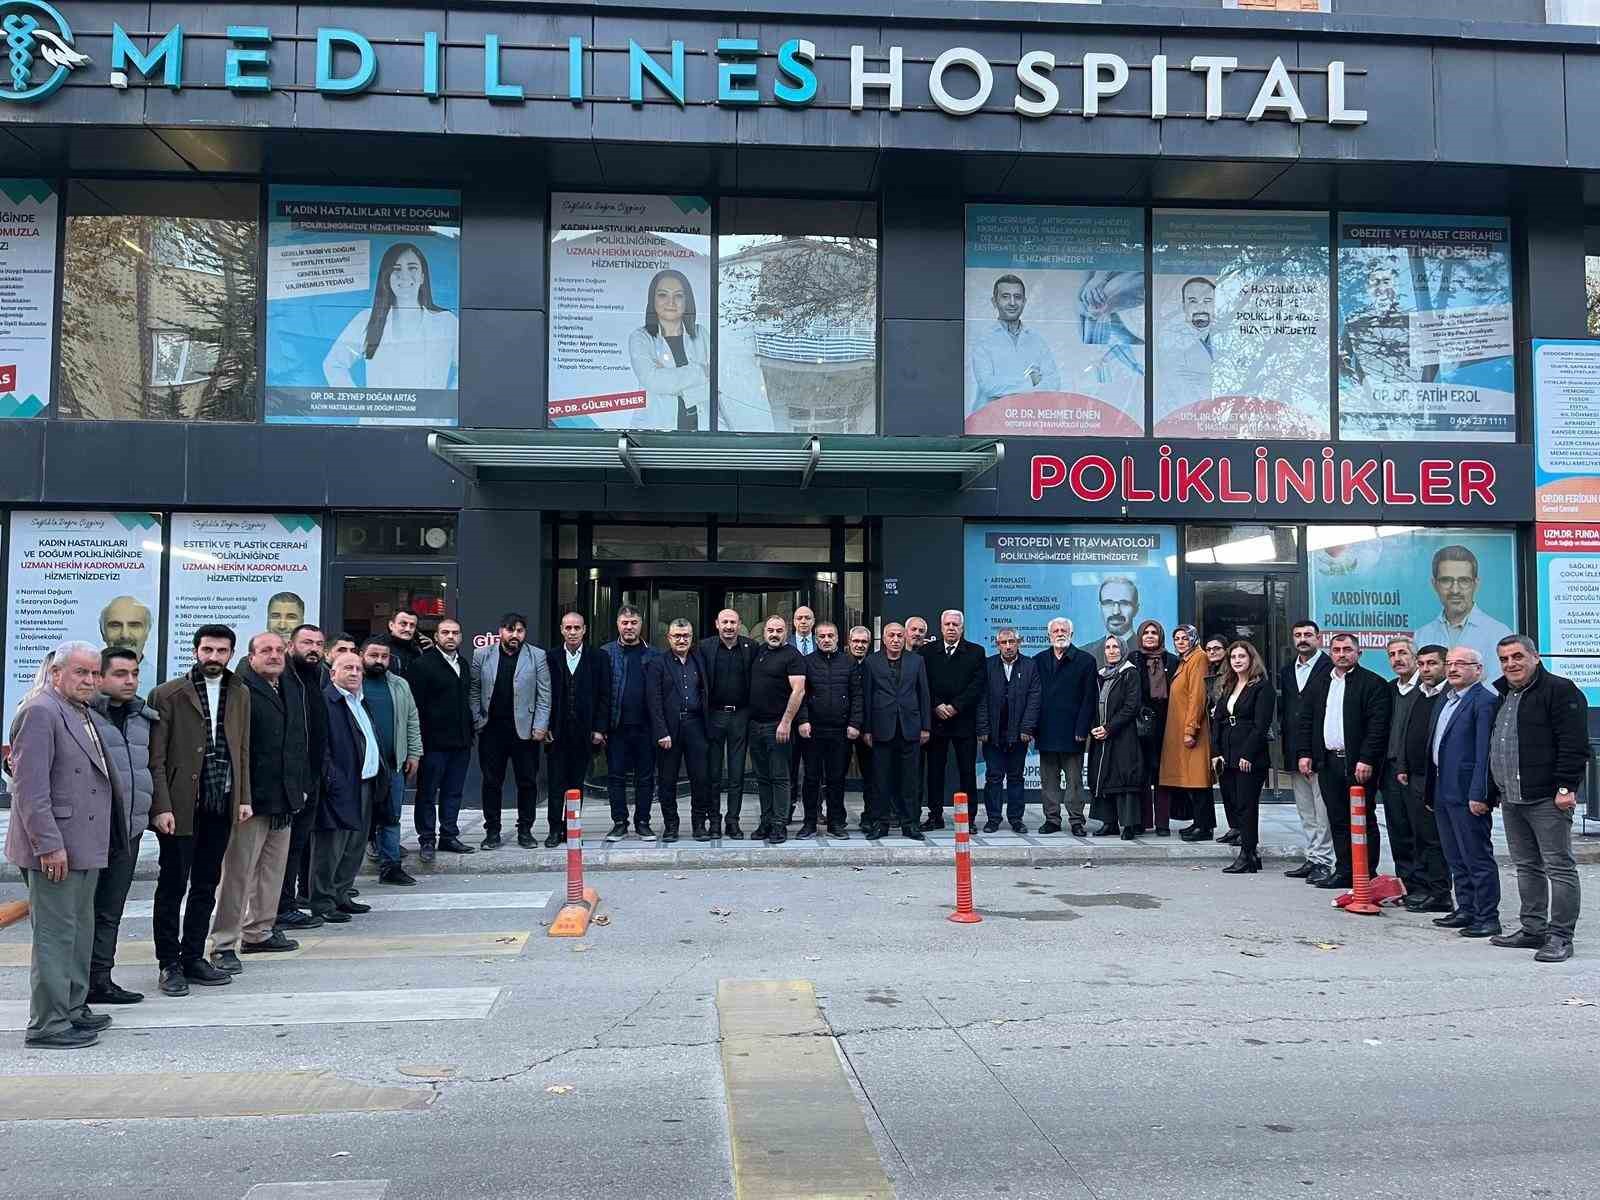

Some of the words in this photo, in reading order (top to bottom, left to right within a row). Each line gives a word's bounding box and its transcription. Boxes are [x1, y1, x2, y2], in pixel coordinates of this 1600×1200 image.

[850, 46, 1368, 125] HOSPITAL
[1396, 228, 1407, 238] VE
[1450, 390, 1481, 403] EROL
[1030, 444, 1496, 506] POLİKLİNİKLER
[39, 539, 67, 547] KADIN
[67, 539, 128, 548] HASTALIKLARI
[183, 540, 220, 549] ESTETİK
[220, 541, 231, 549] VE
[233, 540, 269, 550] PLASTİK
[269, 541, 308, 551] CERRAHİ
[998, 535, 1053, 548] ORTOPEDİ
[1055, 536, 1071, 547] VE
[1073, 535, 1155, 549] TRAVMATOLOJİ
[24, 549, 36, 558] VE
[38, 548, 73, 559] DOĞUM
[74, 548, 143, 559] POLİKLİNİĞİNDE
[21, 560, 53, 570] UZMAN
[54, 559, 83, 570] HEKİM
[84, 561, 145, 570] KADROMUZLA
[182, 563, 217, 571] UZMAN
[218, 562, 245, 572] HEKİM
[247, 563, 308, 572] KADROMUZLA
[44, 571, 120, 581] HİZMETİNİZDEYİZ!
[1331, 589, 1401, 606] KARDİYOLOJİ
[1325, 611, 1409, 628] POLİKLİNİĞİNDE
